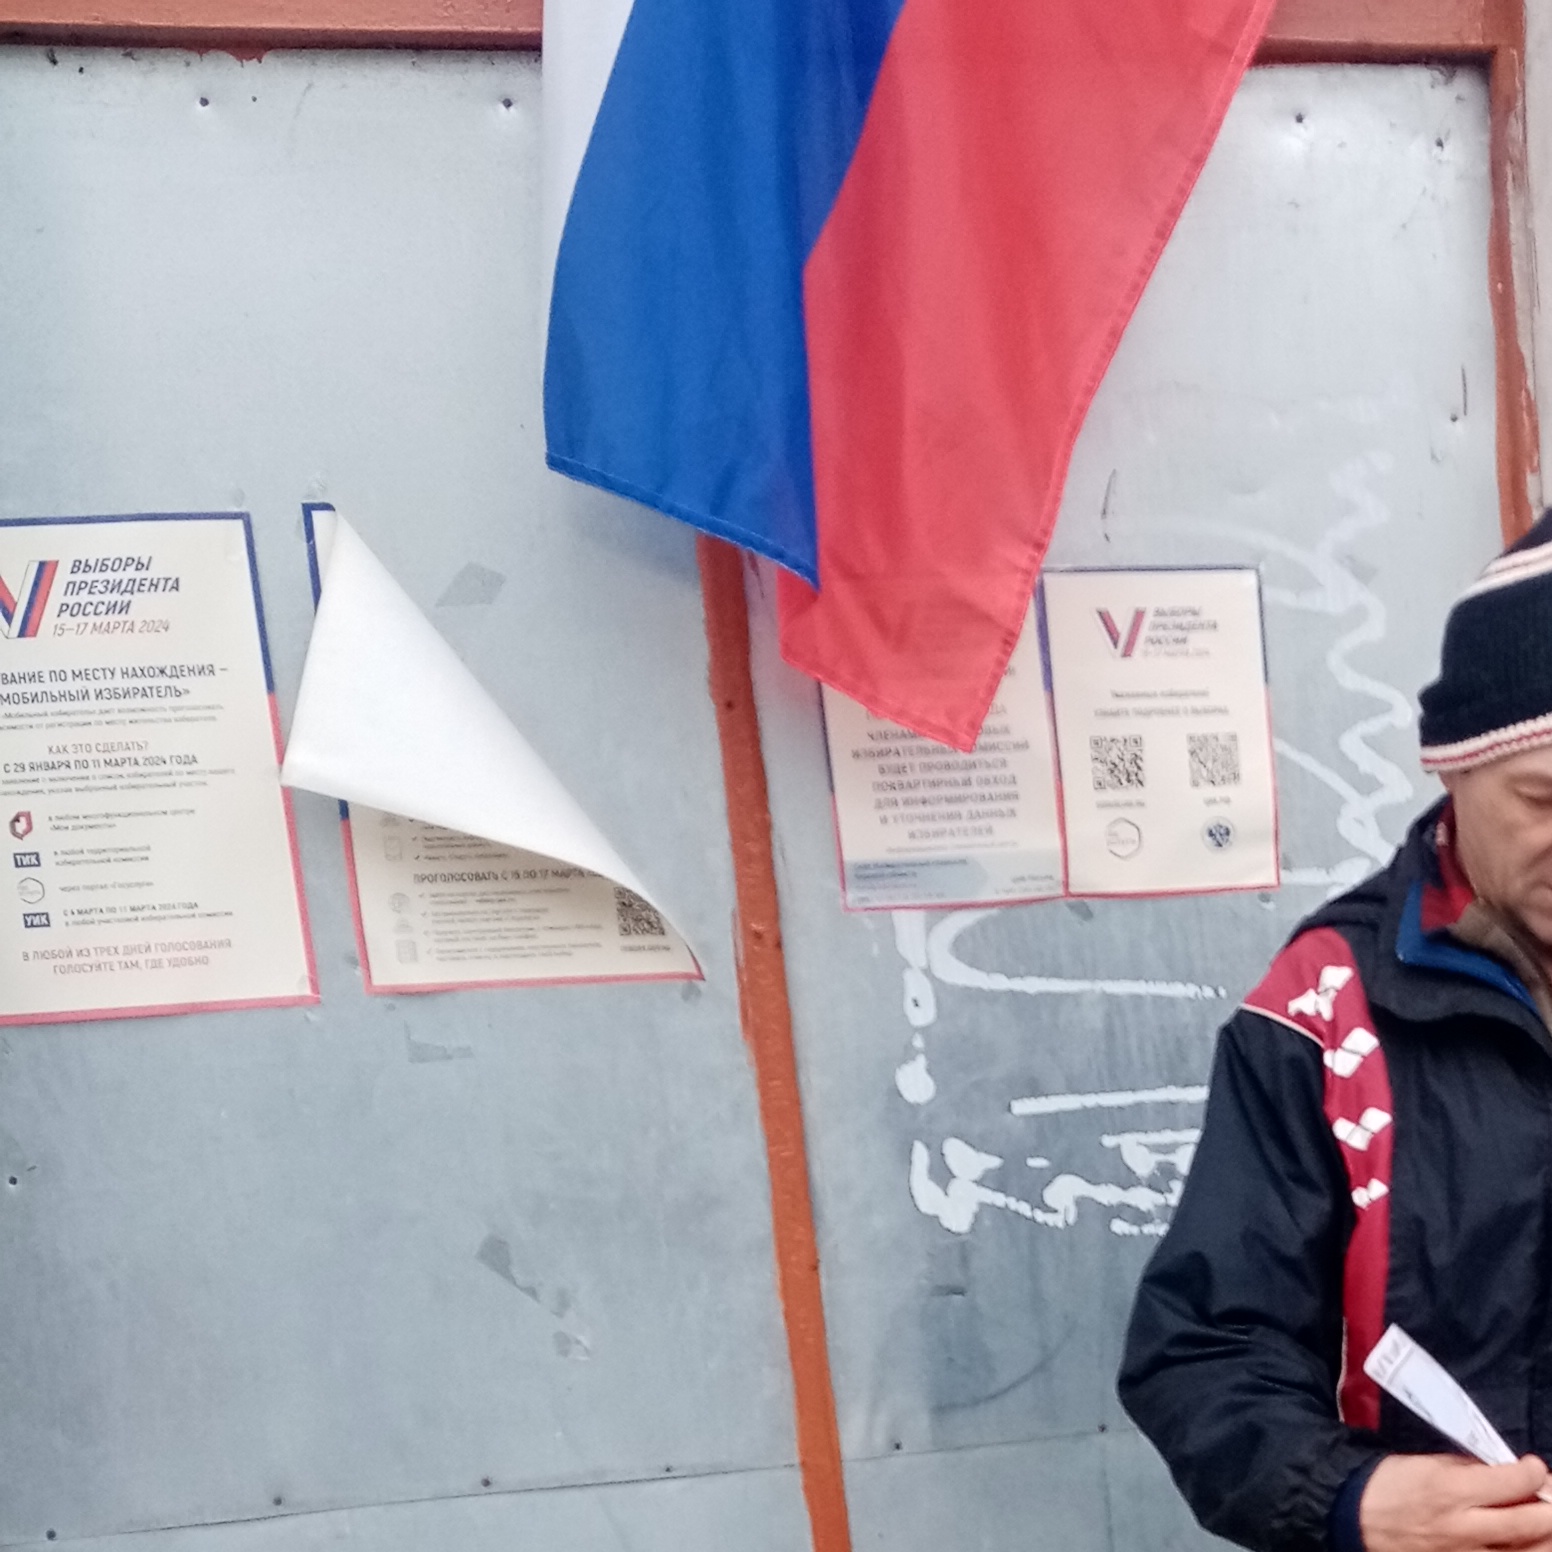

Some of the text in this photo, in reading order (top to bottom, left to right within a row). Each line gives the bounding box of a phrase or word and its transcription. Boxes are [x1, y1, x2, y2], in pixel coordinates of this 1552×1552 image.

[70, 556, 152, 575] ВЫБОРЫ
[63, 577, 180, 597] ПРЕЗИДЕНТА
[56, 600, 132, 618] РОССИИ
[90, 621, 137, 636] МАРТА
[140, 619, 170, 634] 2024
[49, 667, 67, 683] ПО
[72, 666, 116, 682] МЕСТУ
[121, 664, 216, 681] НАХОЖДЕНИЯ
[94, 684, 190, 702] ИЗБИРАТЕЛЬ»
[47, 741, 149, 755] КАК ЭТО СДЕЛАТЬ?
[13, 762, 26, 773] 29
[29, 759, 71, 772] ЯНВАРЯ
[74, 759, 89, 770] ПО
[91, 758, 101, 769] 11
[103, 756, 140, 768] МАРТА
[142, 755, 167, 767] 2024
[169, 754, 199, 766] ГОДА
[16, 854, 40, 867] ТИК
[25, 914, 49, 927] УИК
[22, 950, 30, 961] В
[32, 946, 73, 961] ЛЮБОЙ
[76, 947, 91, 959] ИЗ
[122, 942, 151, 957] ДНЕЙ
[154, 939, 232, 954] ГОЛОСОВАНИЯ
[53, 960, 115, 975] ГОЛОСУЙТЕ
[144, 957, 165, 970] ГДЕ
[166, 955, 209, 969] УДОБНО
